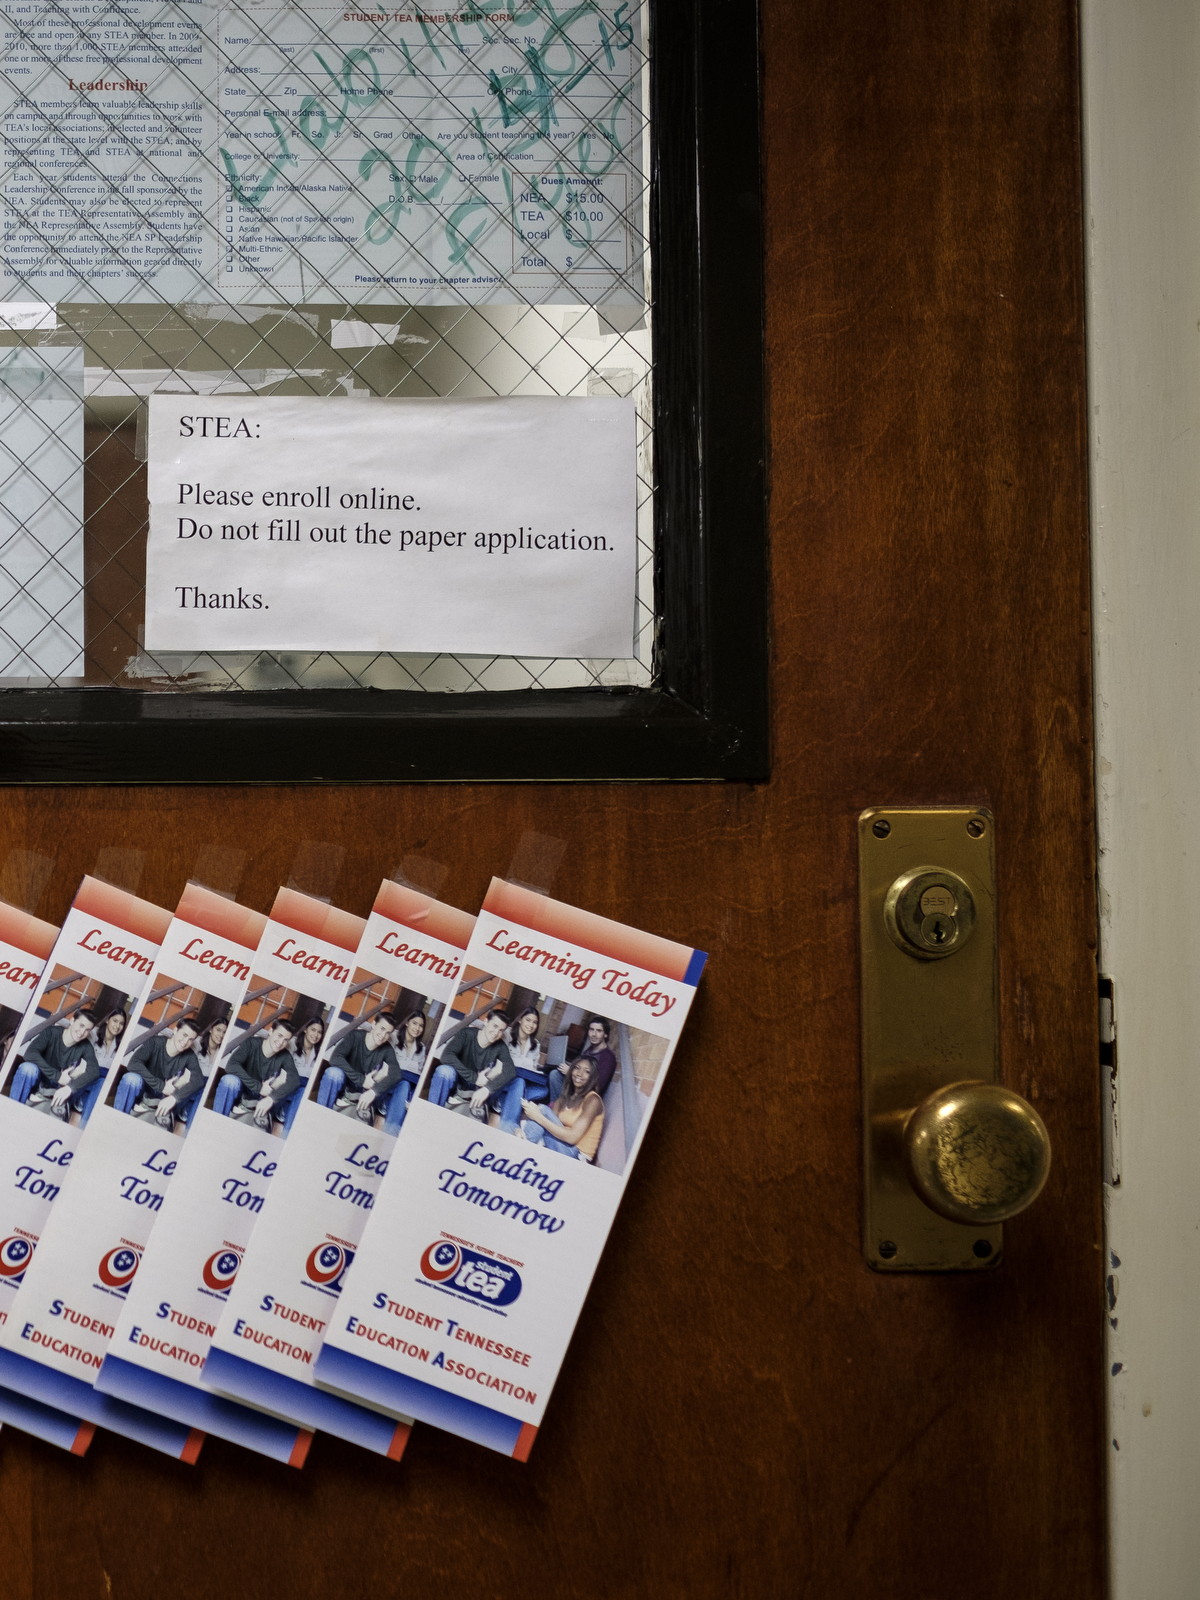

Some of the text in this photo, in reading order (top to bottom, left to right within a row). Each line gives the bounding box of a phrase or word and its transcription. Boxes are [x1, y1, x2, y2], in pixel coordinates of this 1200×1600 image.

[343, 13, 515, 23] STUDENT TEA MEMBERSHIP FORM
[224, 37, 251, 45] Name:
[224, 66, 517, 75] Address: City
[68, 79, 148, 92] Leadership
[224, 88, 246, 96] State
[284, 87, 297, 97] Zip
[341, 88, 364, 96] Home
[367, 88, 394, 96] Phone
[505, 88, 532, 96] Phone
[224, 110, 260, 118] Personal
[541, 178, 603, 186] Dues Amount:
[520, 193, 603, 203] NEA $15.00
[521, 211, 603, 222] TEA $10.00
[520, 230, 572, 240] Local $
[521, 257, 572, 268] Total $
[355, 275, 503, 286] Please return to your chapter advisor.
[179, 415, 261, 439] STEA:
[177, 483, 421, 511] Please enroll online.
[177, 517, 615, 555] Do not fill out the paper application.
[175, 586, 269, 611] Thanks.
[486, 929, 677, 1017] Learning Today
[459, 1141, 565, 1202] Leading
[438, 1169, 565, 1234] Tomorrow
[476, 1260, 514, 1280] student
[496, 1253, 524, 1267] TEACHERS
[454, 1264, 505, 1300] tea
[49, 1299, 115, 1339] STUDENT
[260, 1295, 326, 1335] STUDENT
[373, 1292, 443, 1332] STUDENT
[447, 1318, 531, 1368] TENNESSEE
[20, 1323, 103, 1370] EDUCATION
[233, 1319, 312, 1365] EDUCATION
[346, 1315, 537, 1406] EDUCATION ASSOCIATION
